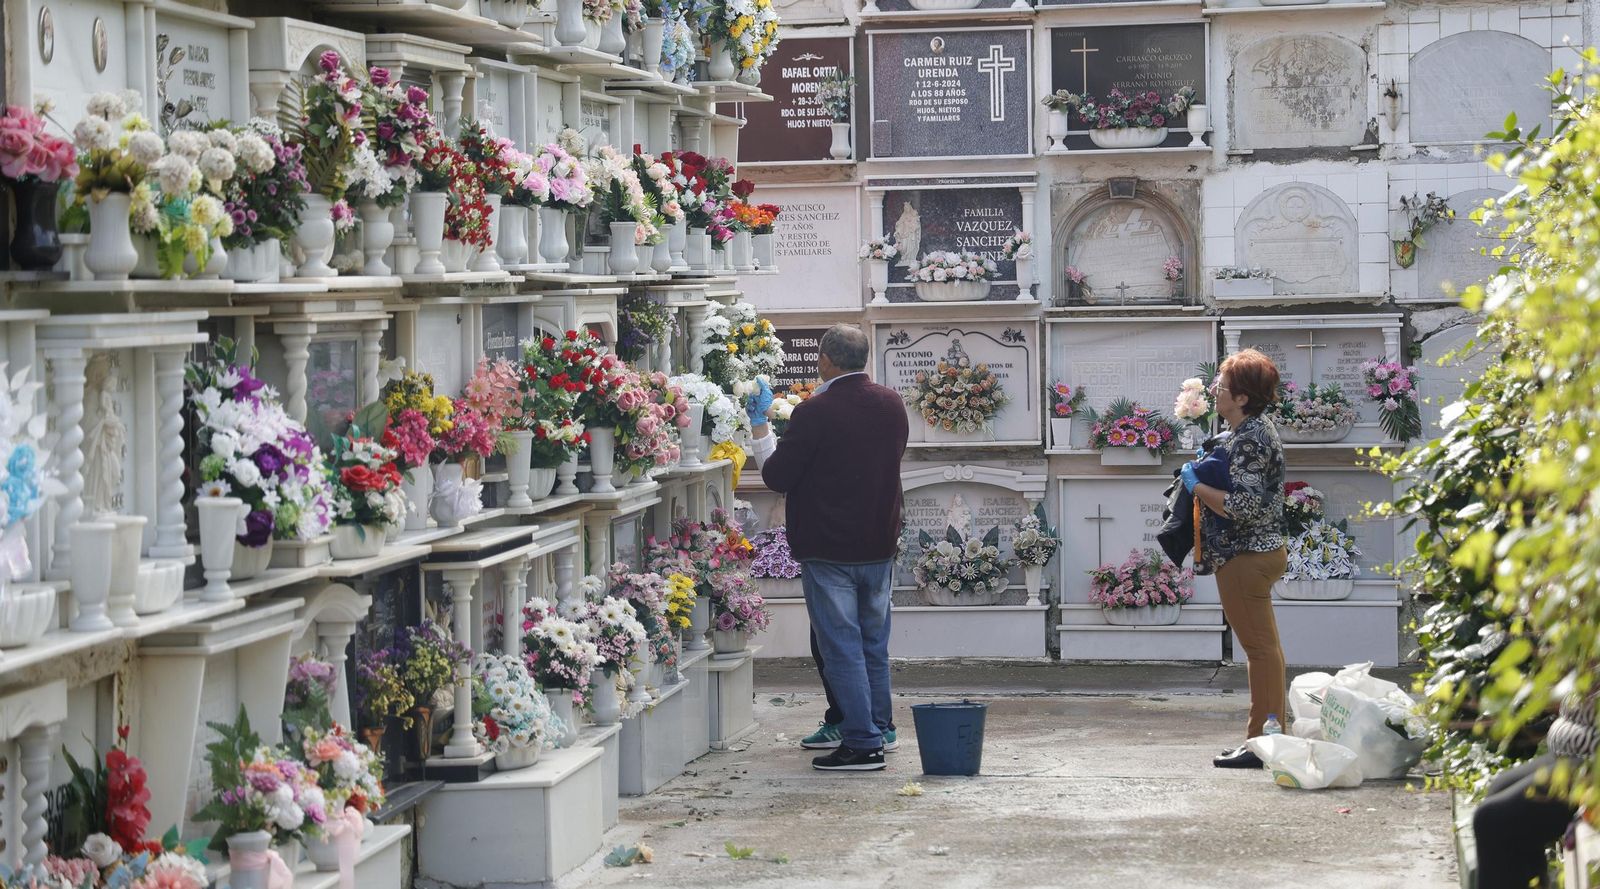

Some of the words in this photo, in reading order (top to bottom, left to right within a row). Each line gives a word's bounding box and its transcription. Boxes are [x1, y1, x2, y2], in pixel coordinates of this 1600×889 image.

[904, 57, 946, 67] CARMEN
[949, 56, 973, 66] RUIZ
[1116, 55, 1157, 63] CARRASCO
[782, 67, 811, 78] RAFAEL
[918, 68, 958, 78] URENDA
[1135, 72, 1173, 80] ANTONIO
[791, 82, 823, 93] MOREN
[922, 80, 961, 88] 12-6-2024
[1149, 80, 1195, 88] RODRIGUEZ
[911, 90, 916, 98] A
[945, 88, 966, 97] AÑOS
[797, 108, 806, 117] DE
[807, 108, 815, 116] SU
[787, 120, 805, 128] HIJOS
[806, 119, 811, 128] Y
[812, 119, 834, 128] NIETOS
[780, 204, 826, 212] RANCISCO
[964, 208, 1004, 217] FAMILIA
[797, 212, 840, 221] SANCHEZ
[792, 222, 814, 231] AÑOS
[956, 220, 1013, 233] VAZQUEZ
[786, 239, 818, 248] CARIÑO
[783, 248, 832, 257] FAMILIARES
[791, 338, 818, 347] TERESA
[783, 353, 802, 361] ARRA
[803, 353, 819, 361] GOD
[892, 360, 936, 368] GALLARDO
[776, 378, 794, 386] ESTOS
[983, 497, 1019, 506] ISABEL
[905, 508, 946, 517] AUTISTA
[978, 507, 1022, 516] SANCHEZ
